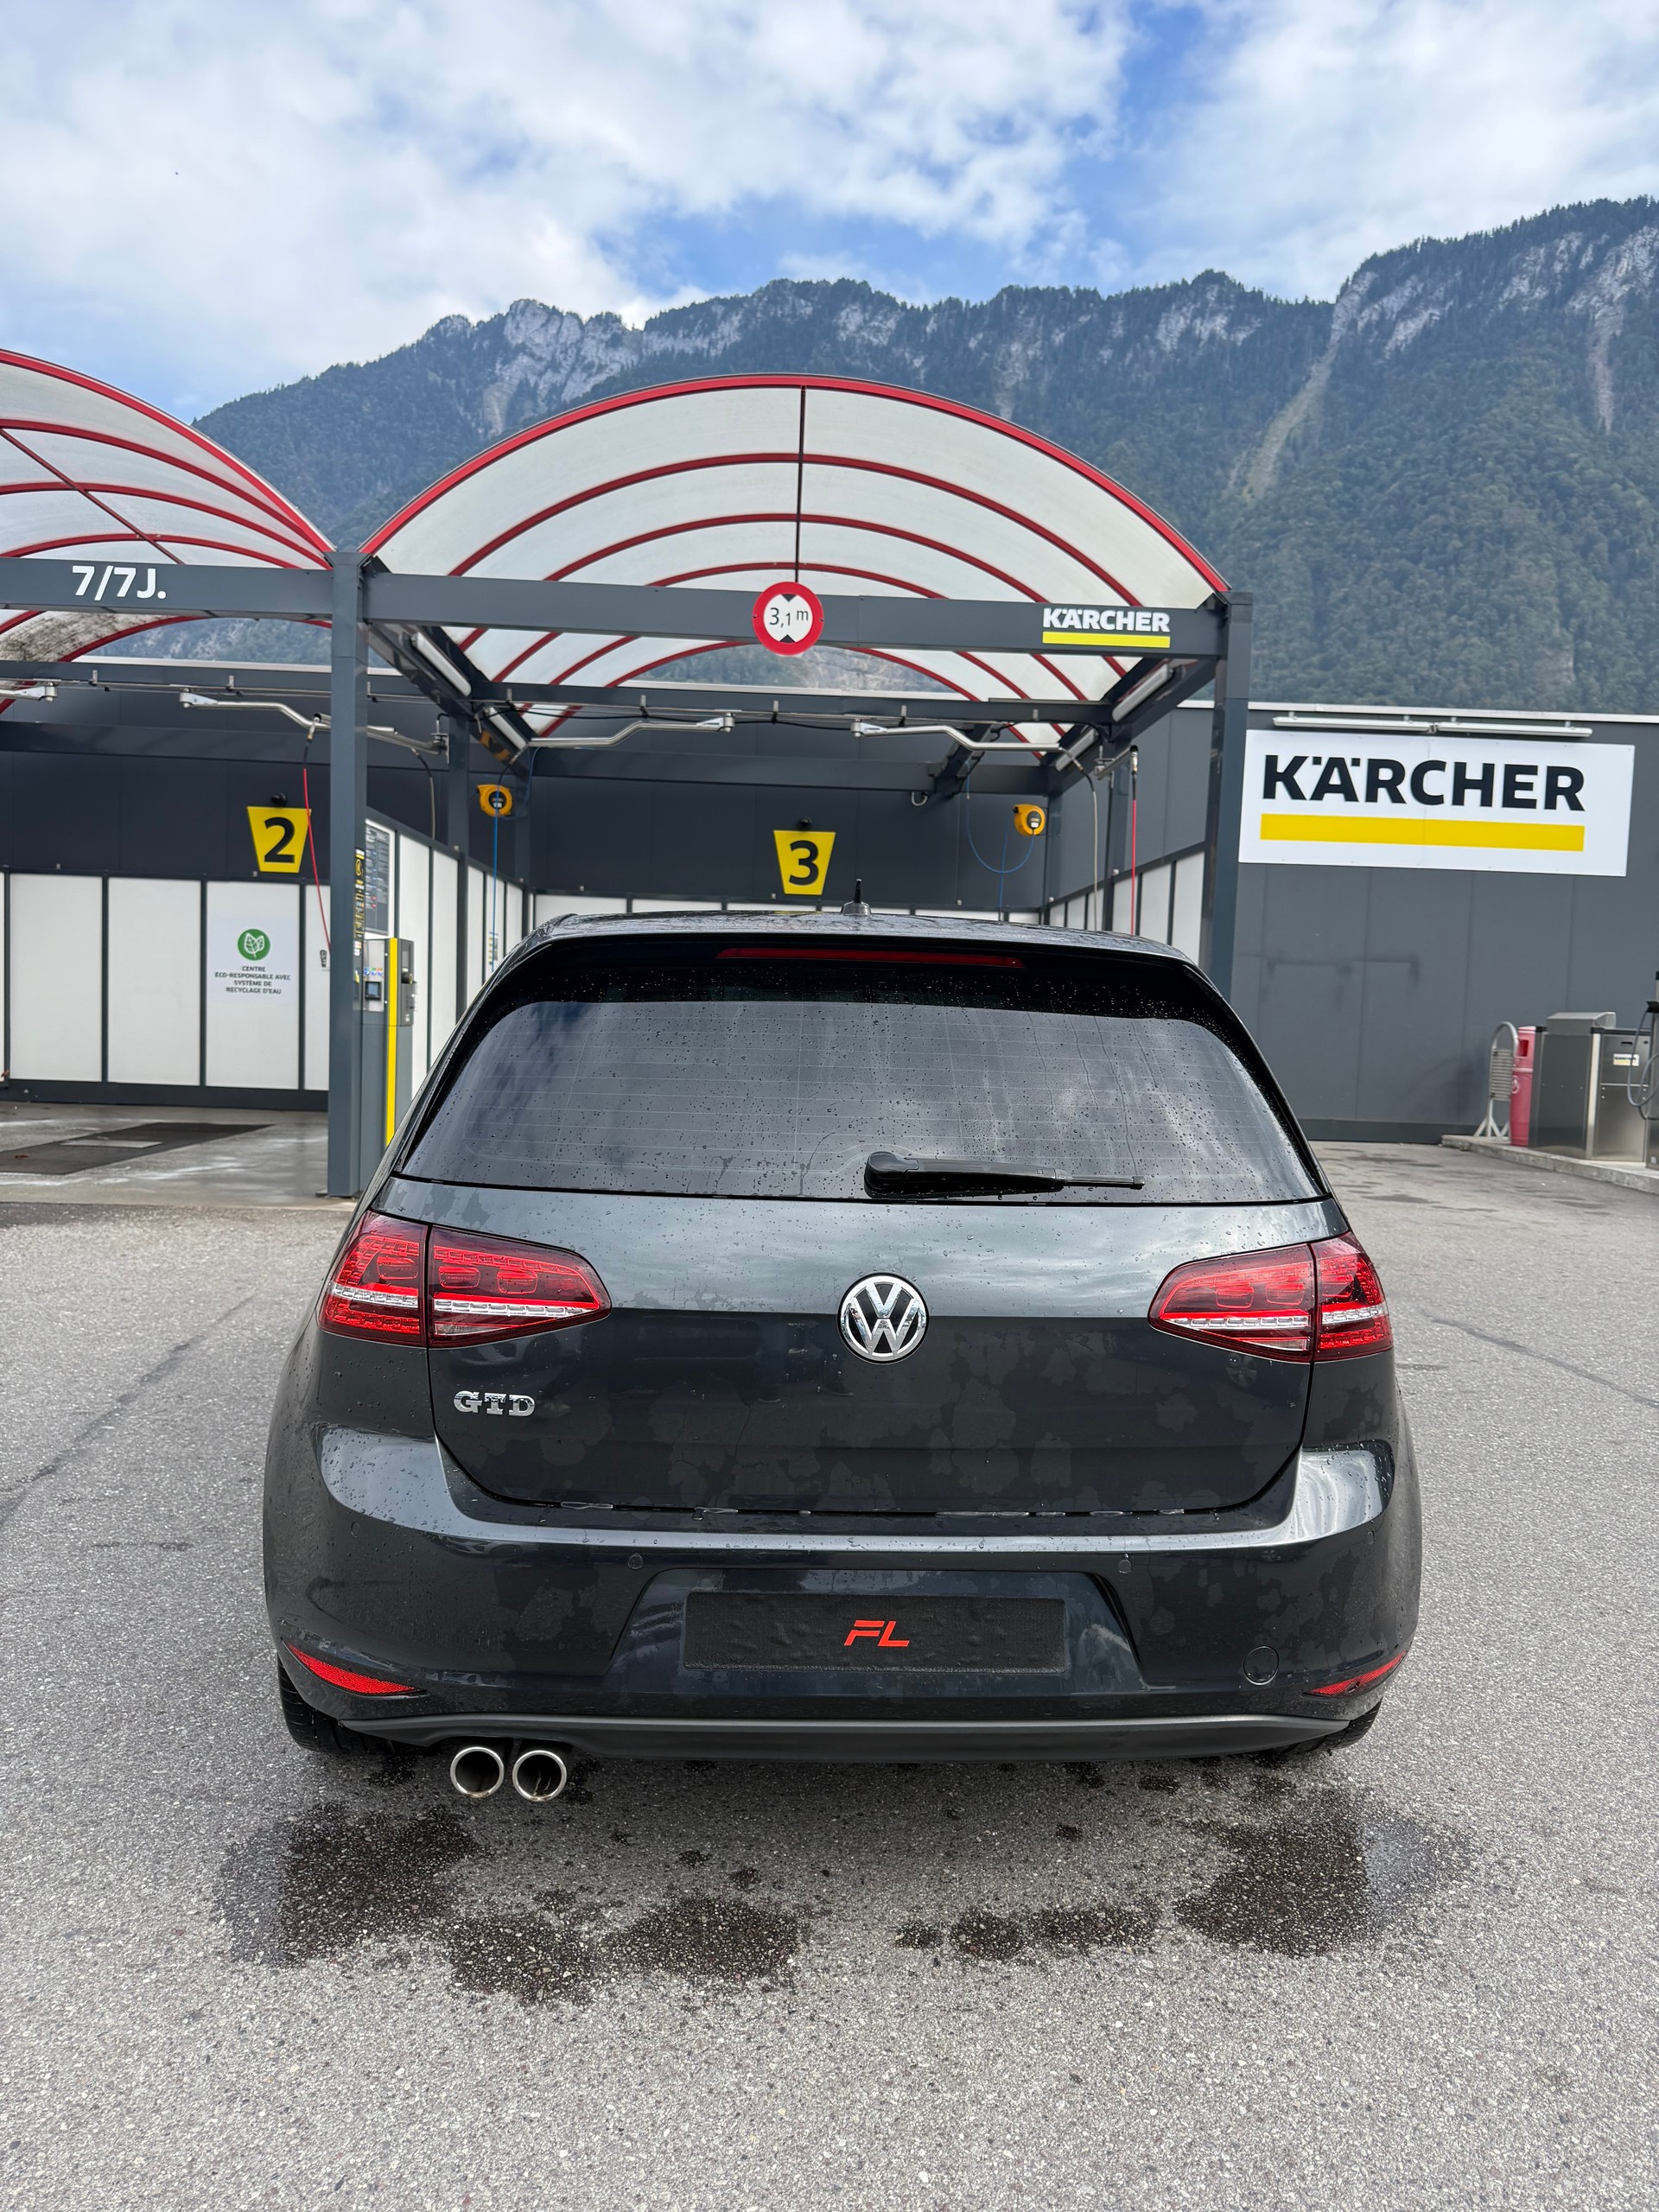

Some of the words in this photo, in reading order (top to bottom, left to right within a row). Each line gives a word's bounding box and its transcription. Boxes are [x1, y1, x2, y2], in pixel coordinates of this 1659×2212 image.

[769, 607, 791, 628] 3,1
[796, 610, 809, 621] m
[1042, 607, 1170, 632] KÄRCHER
[1262, 754, 1585, 811] KÄRCHER
[264, 817, 296, 863] 2
[789, 840, 819, 887] 3
[454, 1390, 536, 1417] GTD
[843, 1619, 910, 1647] FL
